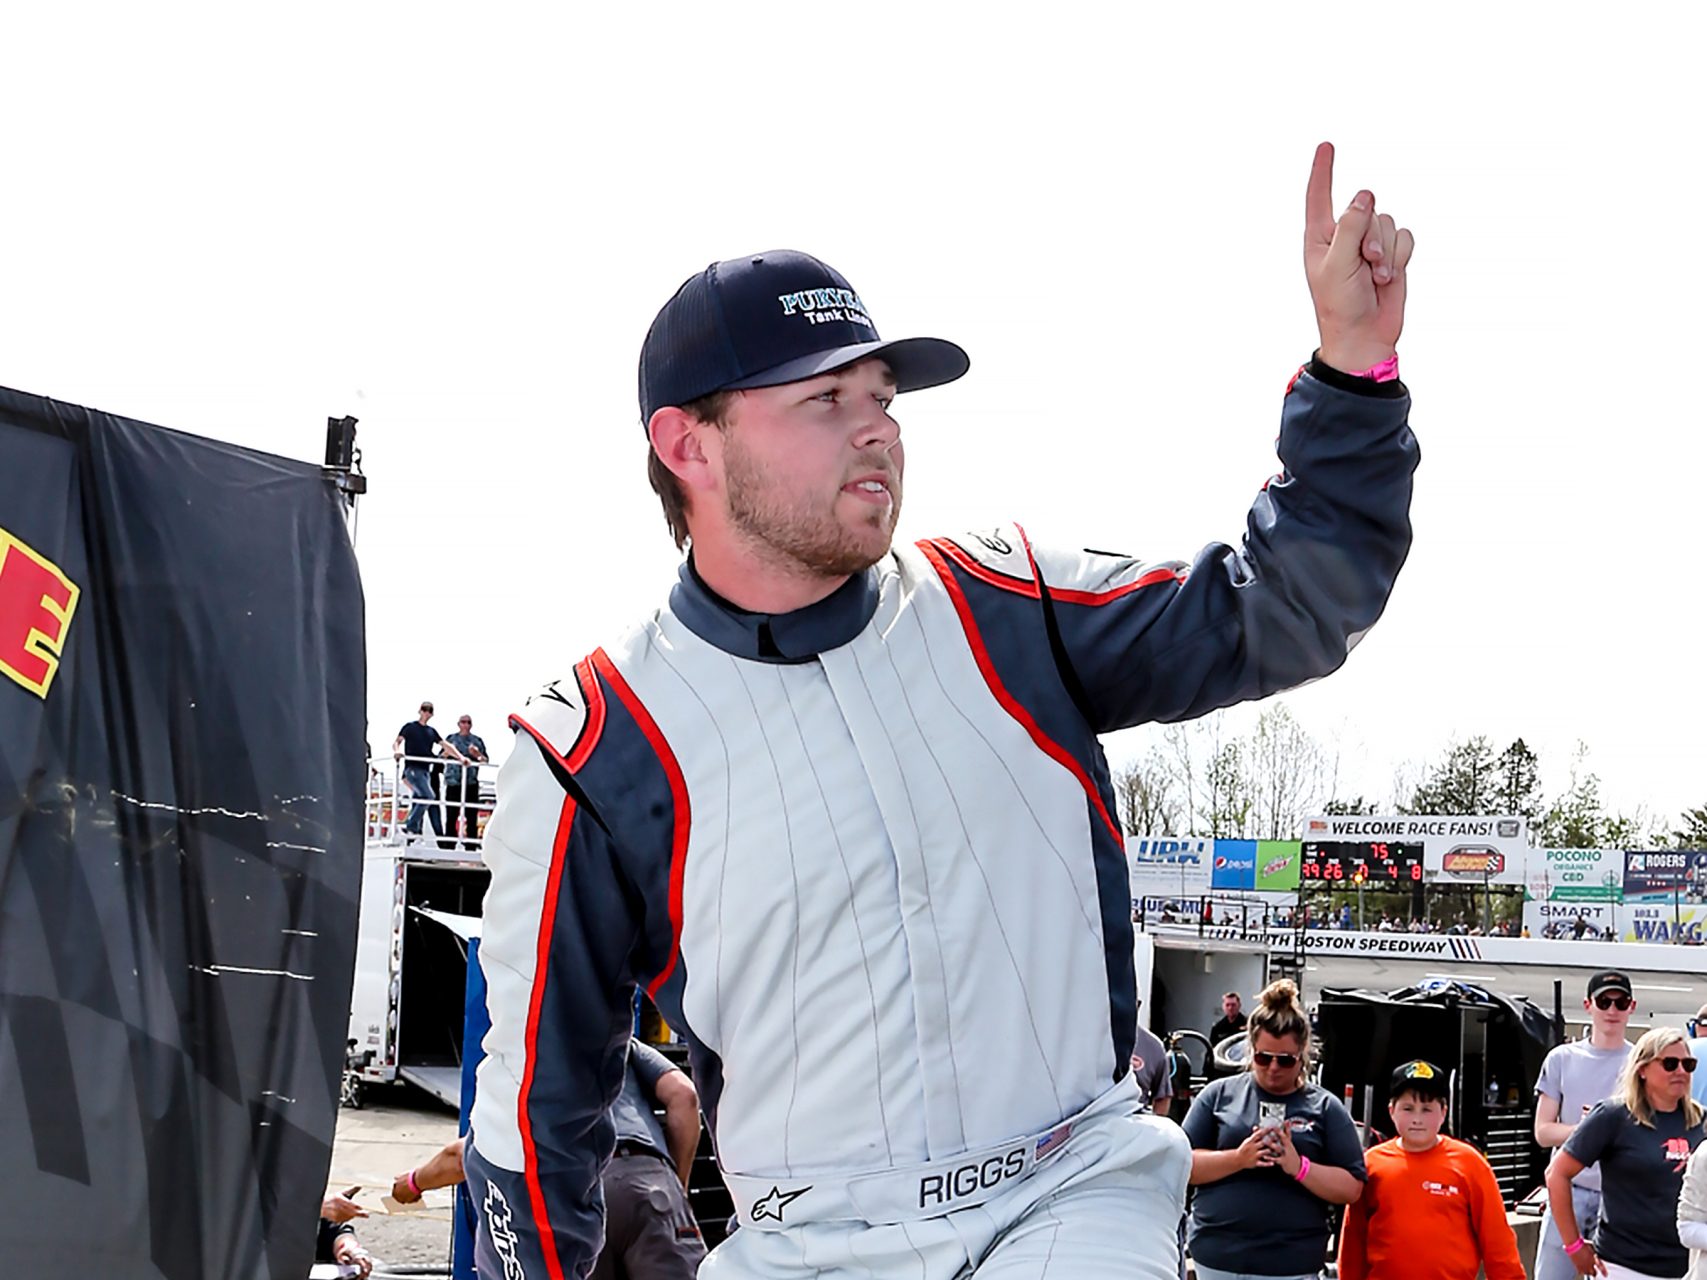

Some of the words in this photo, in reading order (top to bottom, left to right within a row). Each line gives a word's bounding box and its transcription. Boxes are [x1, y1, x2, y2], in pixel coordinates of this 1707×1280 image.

[804, 309, 844, 325] Tank
[1332, 821, 1405, 835] WELCOME
[1407, 822, 1446, 836] RACE
[1448, 822, 1493, 836] FANS!
[1370, 843, 1389, 859] 75
[1546, 850, 1602, 861] POCONO
[1553, 863, 1594, 871] ORGANICS
[1646, 854, 1686, 868] ROGERS
[1323, 863, 1343, 880] 26
[1387, 865, 1398, 879] 4
[1411, 865, 1421, 881] 8
[1540, 905, 1604, 918] SMART
[1358, 938, 1448, 955] SPEEDWAY
[919, 1147, 1026, 1209] RIGGS
